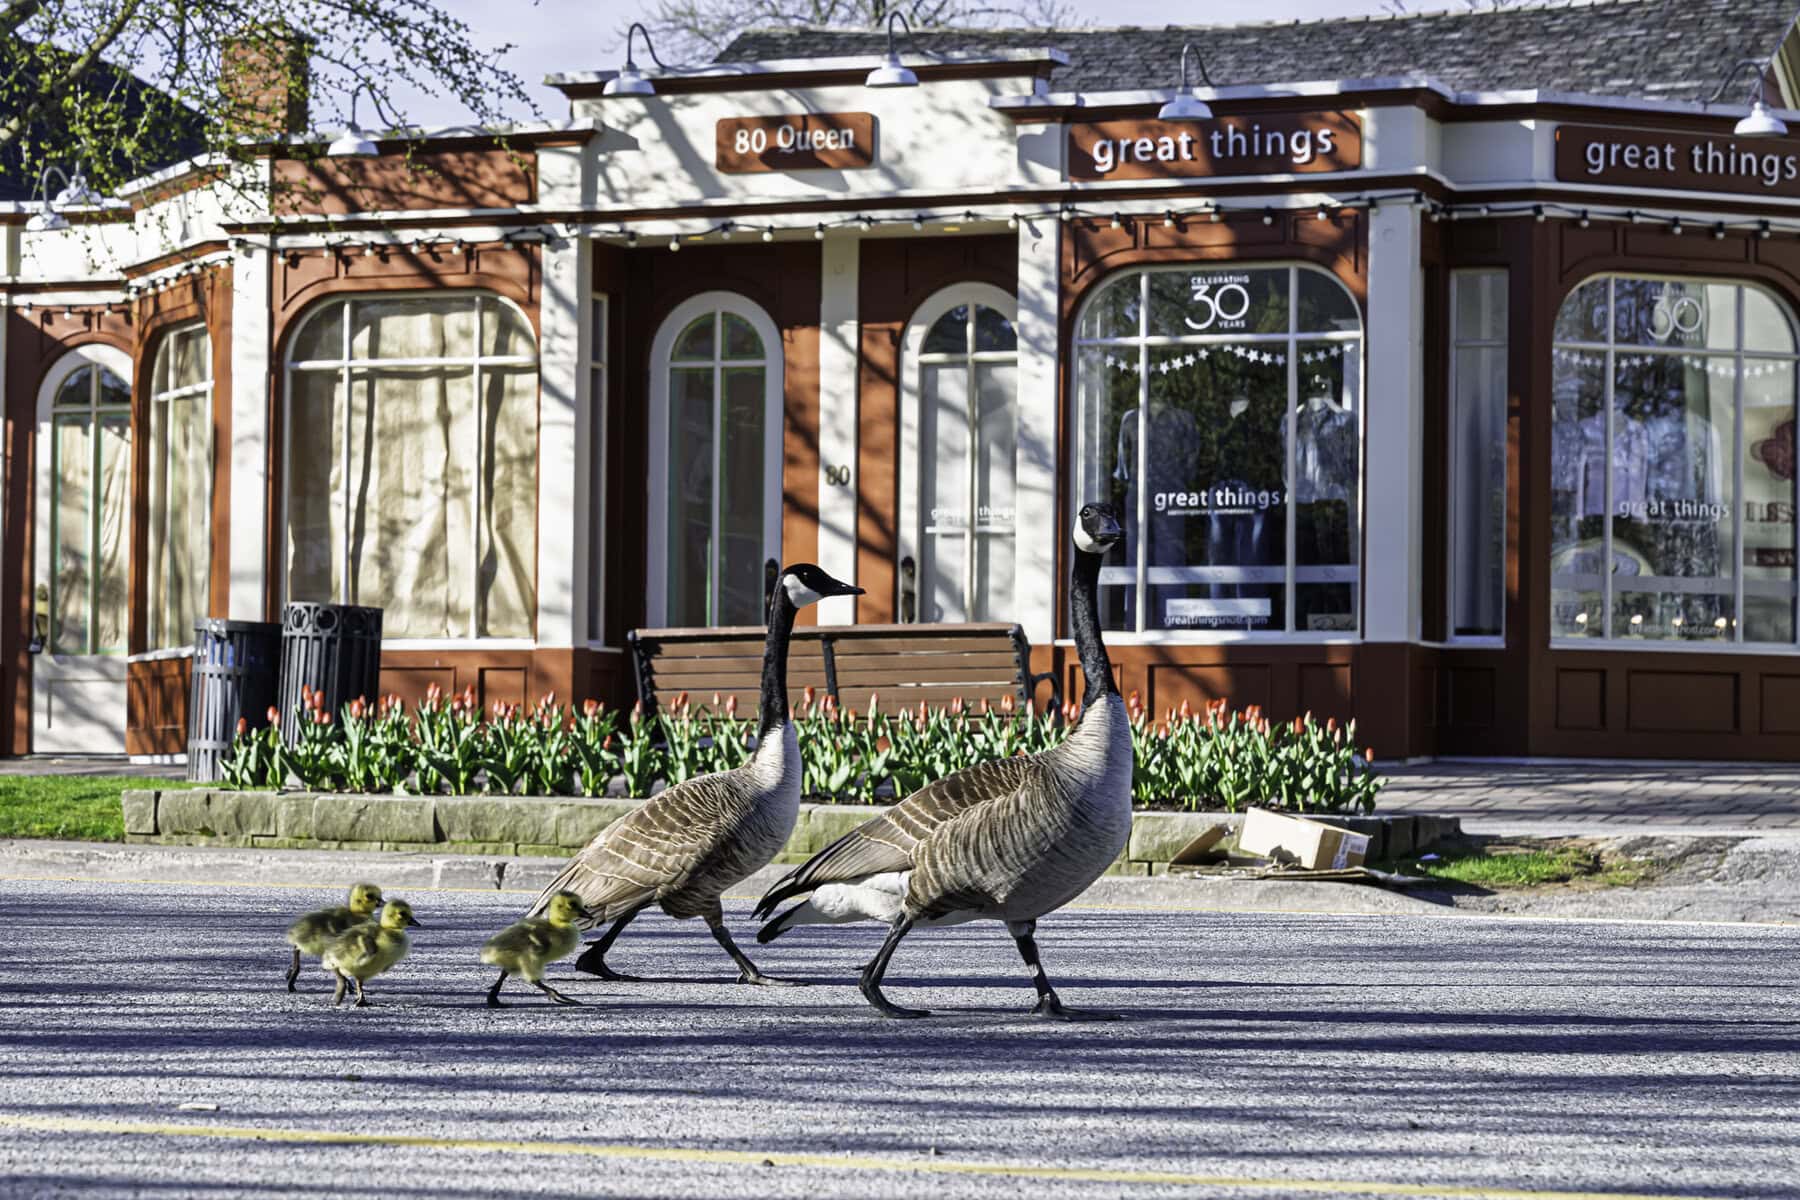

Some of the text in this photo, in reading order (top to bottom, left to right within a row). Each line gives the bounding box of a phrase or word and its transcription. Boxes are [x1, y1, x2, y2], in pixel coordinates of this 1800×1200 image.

[735, 124, 854, 154] 80 Queen
[1092, 124, 1334, 172] great things
[1586, 141, 1798, 187] great things
[1191, 275, 1249, 285] CELEBRATING
[1185, 284, 1250, 330] 30
[1218, 320, 1246, 329] YEARS
[825, 465, 850, 487] 80
[1154, 486, 1280, 512] great things
[1619, 499, 1666, 519] great
[1674, 498, 1730, 522] things
